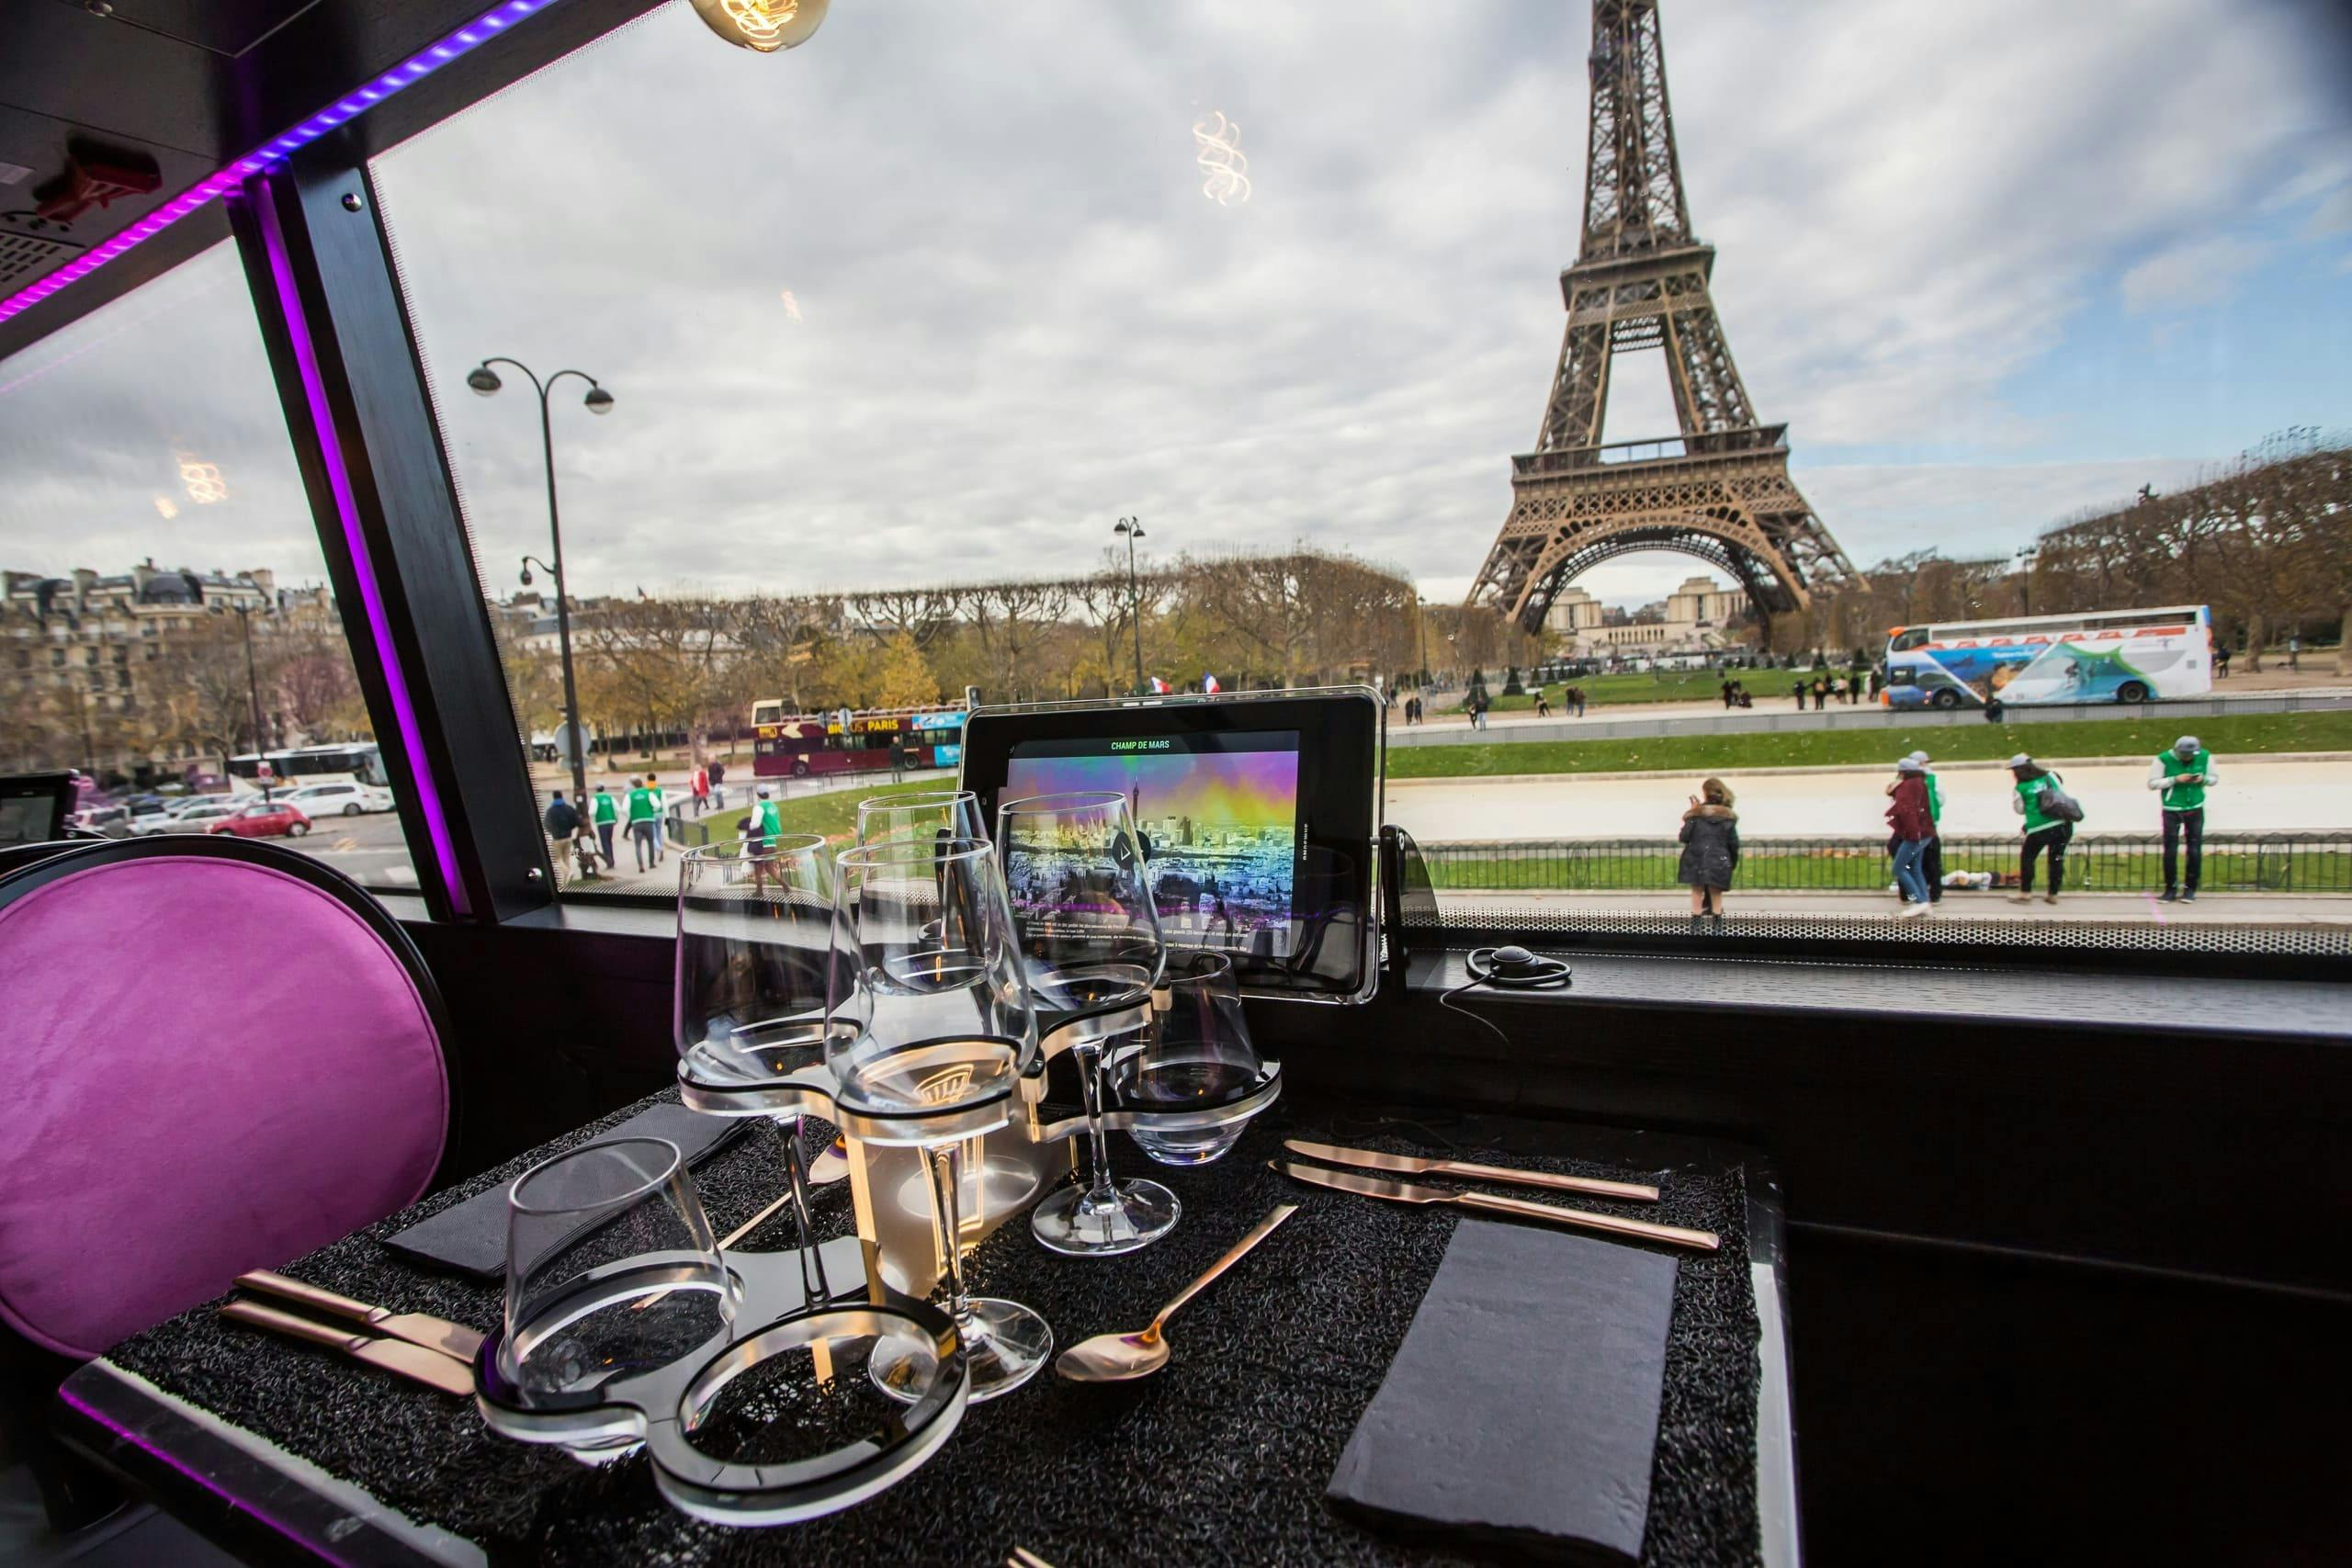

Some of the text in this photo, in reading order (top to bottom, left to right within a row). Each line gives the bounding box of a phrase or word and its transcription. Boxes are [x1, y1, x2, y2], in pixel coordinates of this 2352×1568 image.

[867, 719, 899, 731] PARIS
[1111, 740, 1170, 750] CHAMP DE MARS
